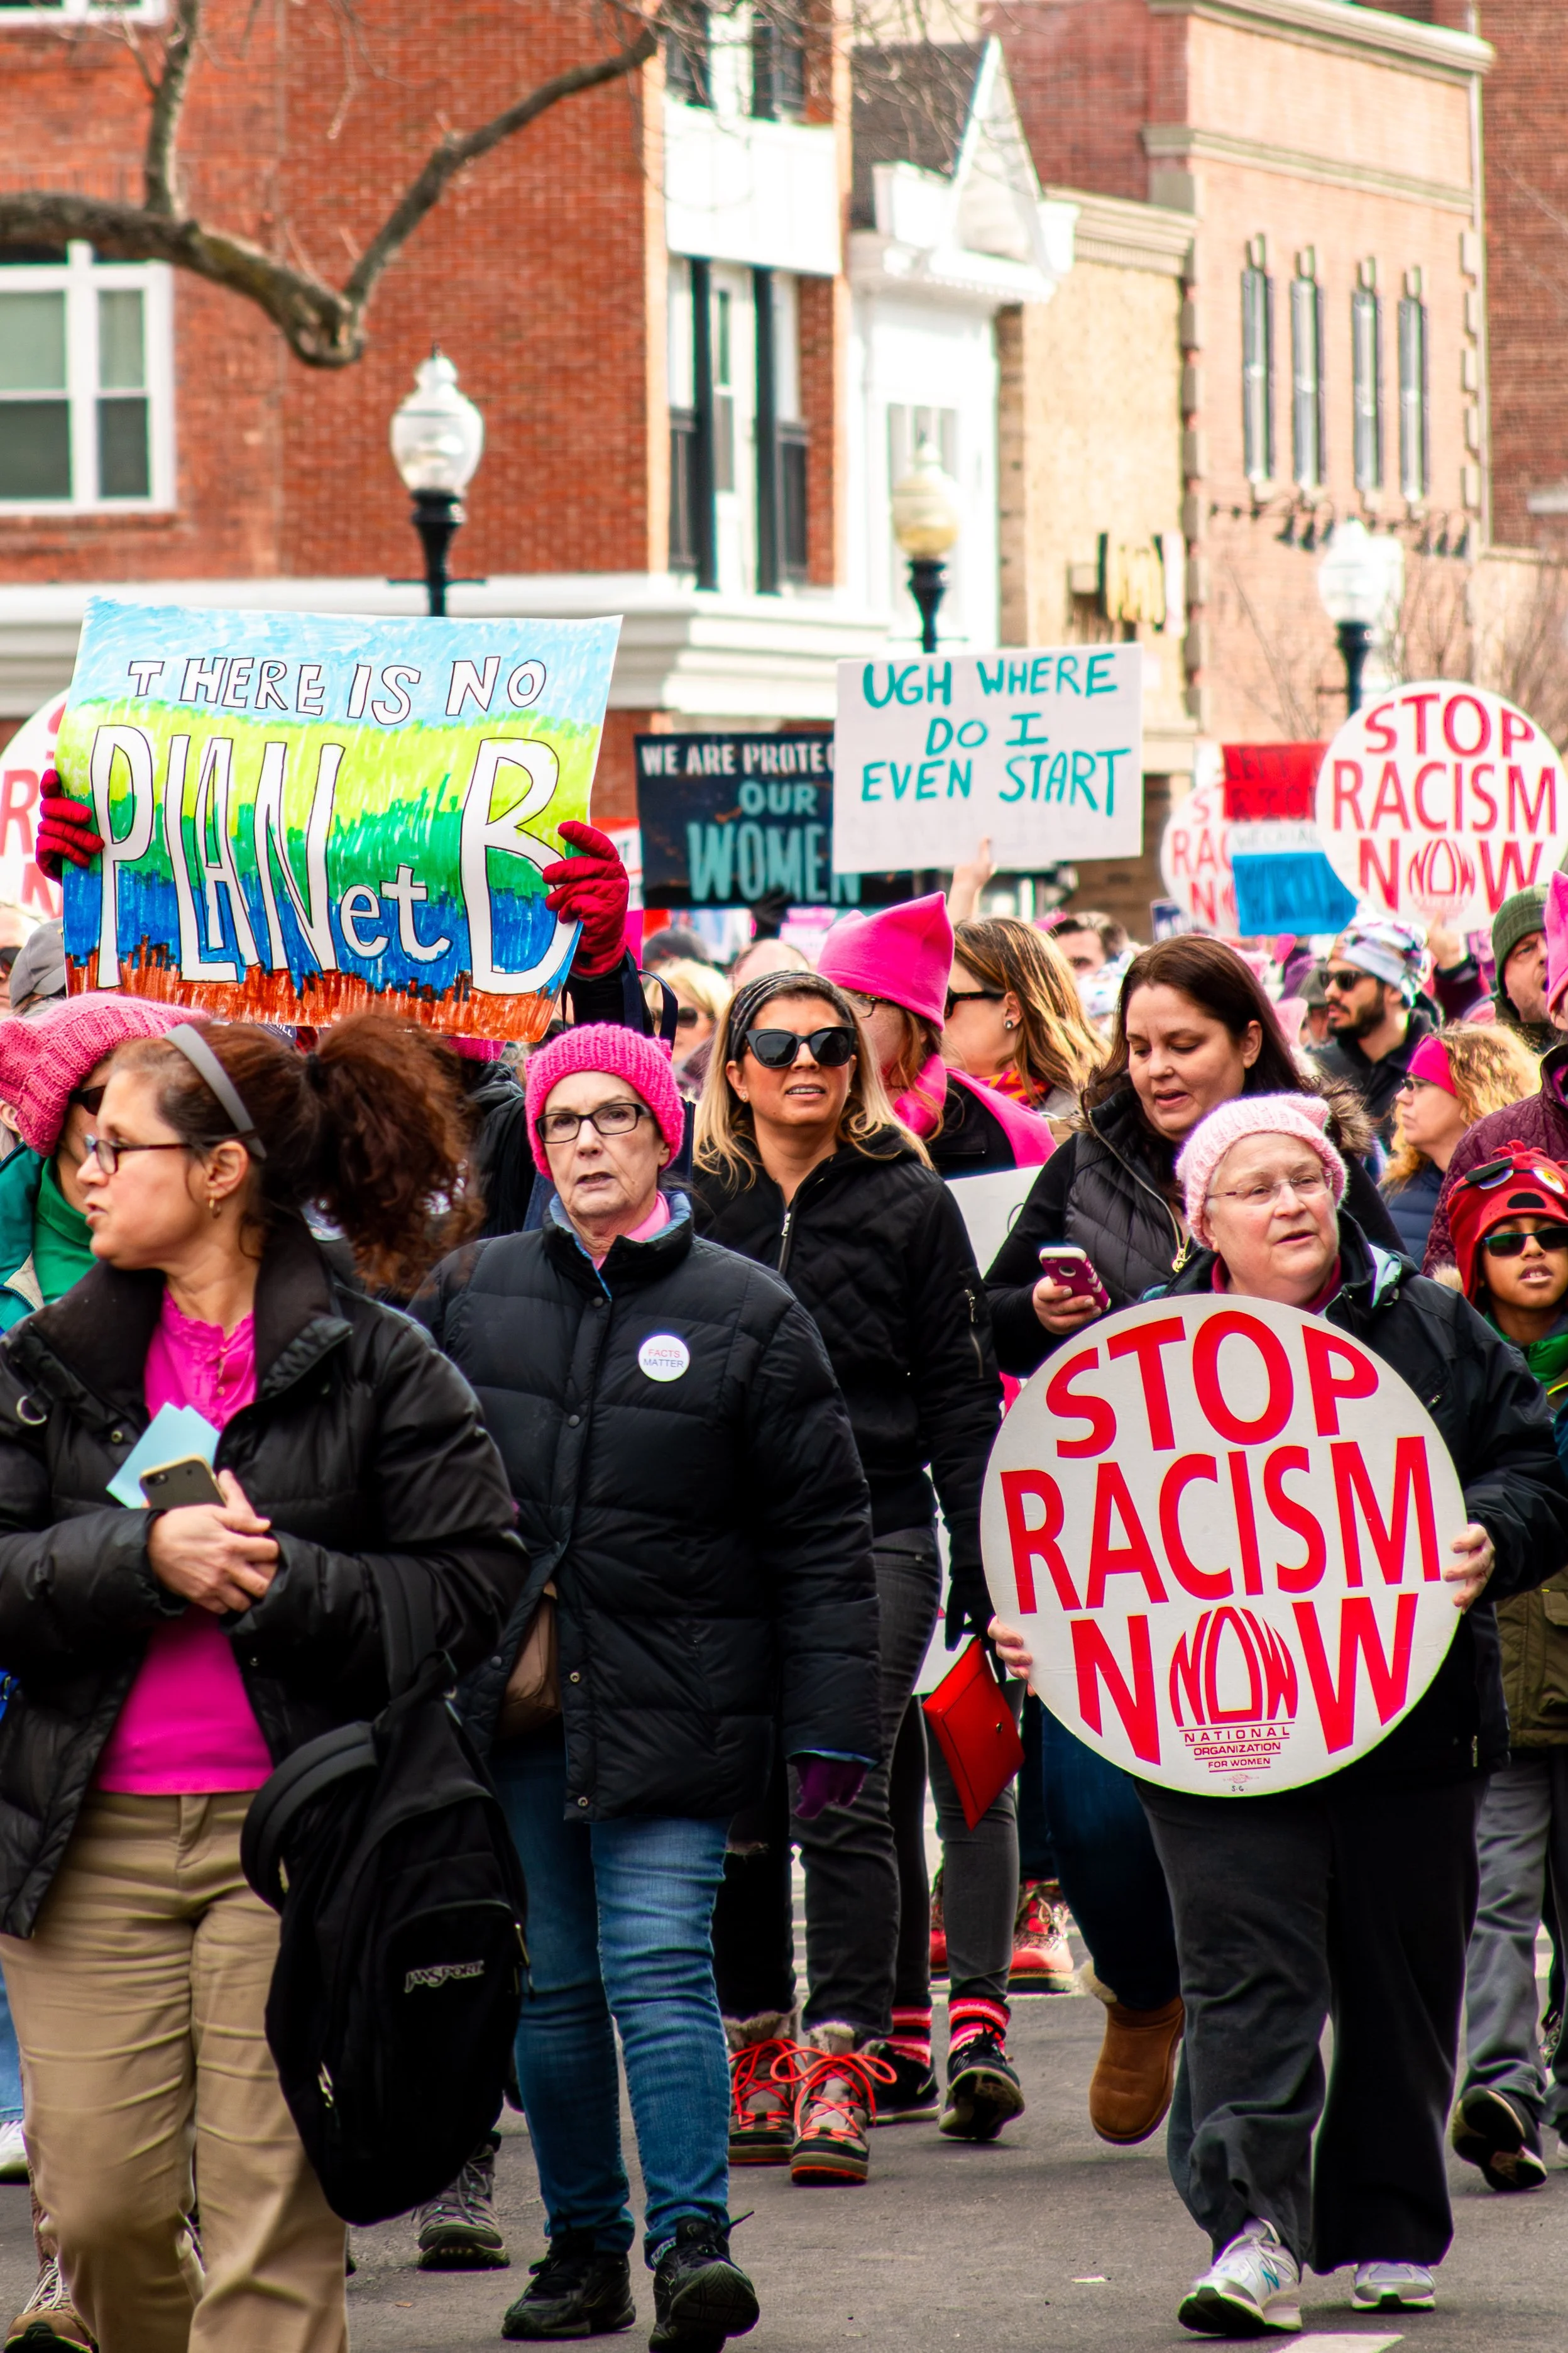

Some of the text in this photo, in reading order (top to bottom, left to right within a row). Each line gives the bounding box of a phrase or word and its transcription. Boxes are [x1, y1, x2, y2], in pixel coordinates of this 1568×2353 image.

[128, 656, 547, 724] THERE IS NO
[862, 652, 1118, 709] UGH WHERE
[926, 712, 1049, 756] DO I
[1363, 692, 1536, 759] STOP
[642, 744, 679, 776] WE
[686, 744, 737, 776] ARE
[861, 747, 1132, 817] EVEN START
[738, 780, 818, 817] OUR
[1332, 759, 1558, 836] RACISM
[90, 724, 582, 996] PLANet B
[643, 1358, 684, 1369] MATTER
[648, 1349, 680, 1358] FACTS
[1045, 1310, 1379, 1458] STOP
[1000, 1436, 1440, 1614] RACISM
[1184, 1726, 1290, 1743] NATIONAL
[1193, 1742, 1281, 1756] ORGANIZATION
[1208, 1758, 1271, 1769] FOR WOMEN
[404, 1959, 485, 1993] JANSPORT
